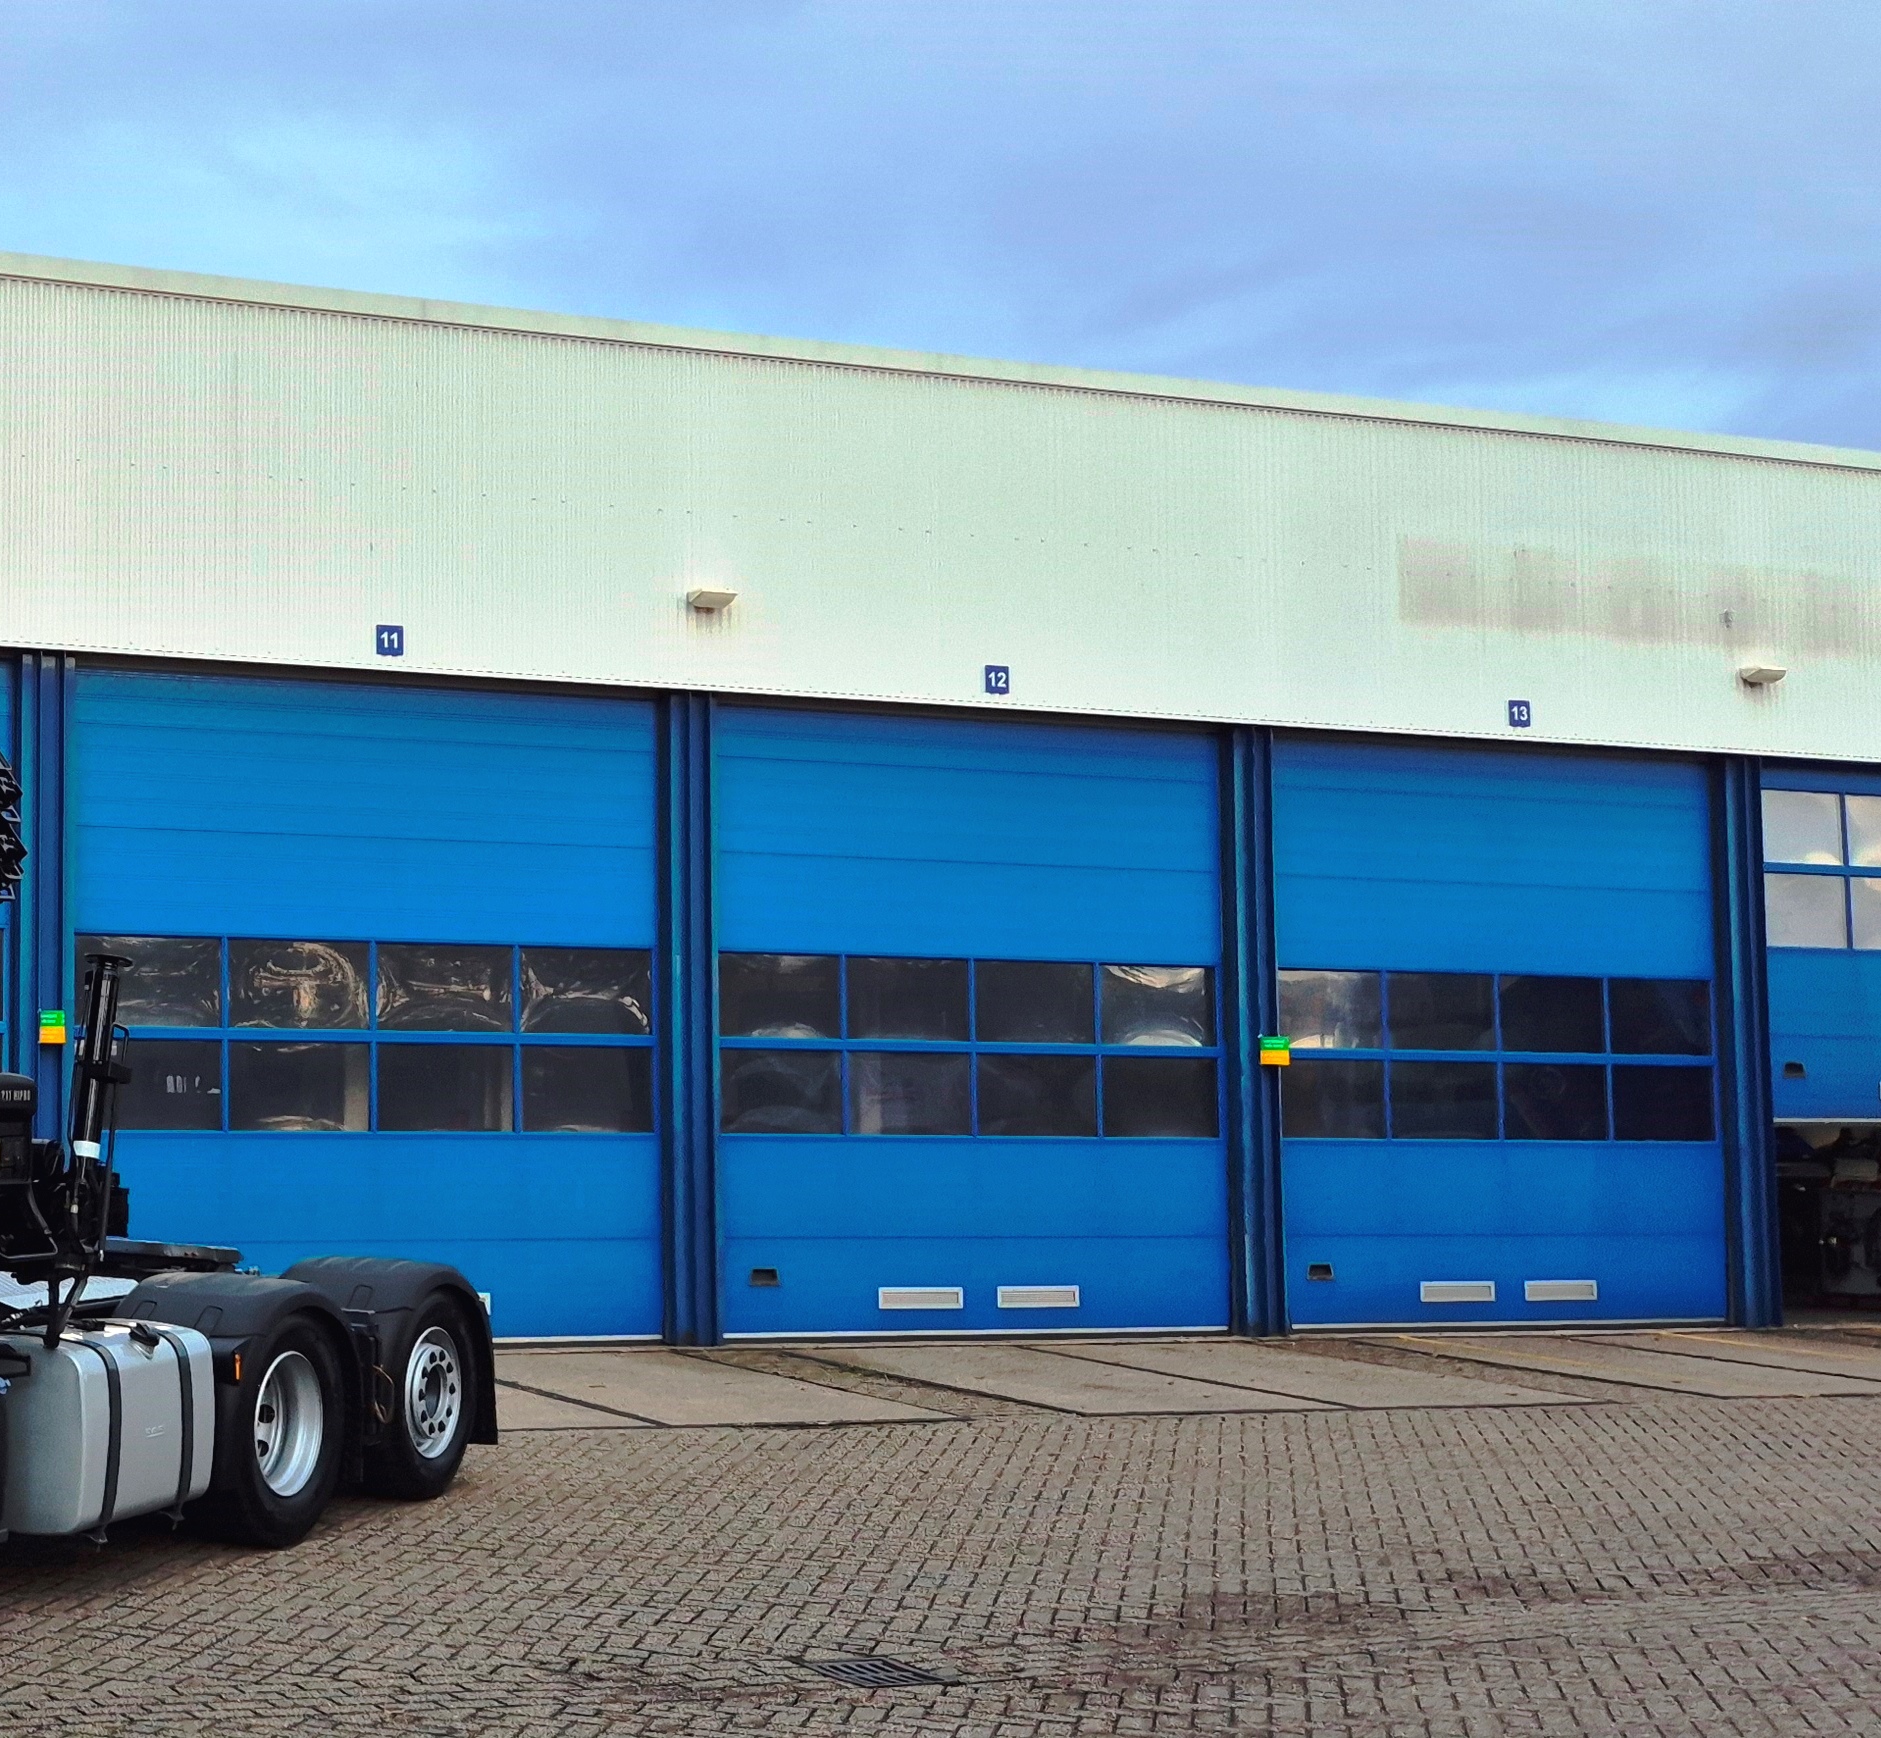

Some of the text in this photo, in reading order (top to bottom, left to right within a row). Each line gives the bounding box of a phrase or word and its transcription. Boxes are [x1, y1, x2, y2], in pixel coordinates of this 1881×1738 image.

[380, 631, 398, 649] 11
[988, 671, 1007, 688] 12
[1511, 705, 1529, 721] 13
